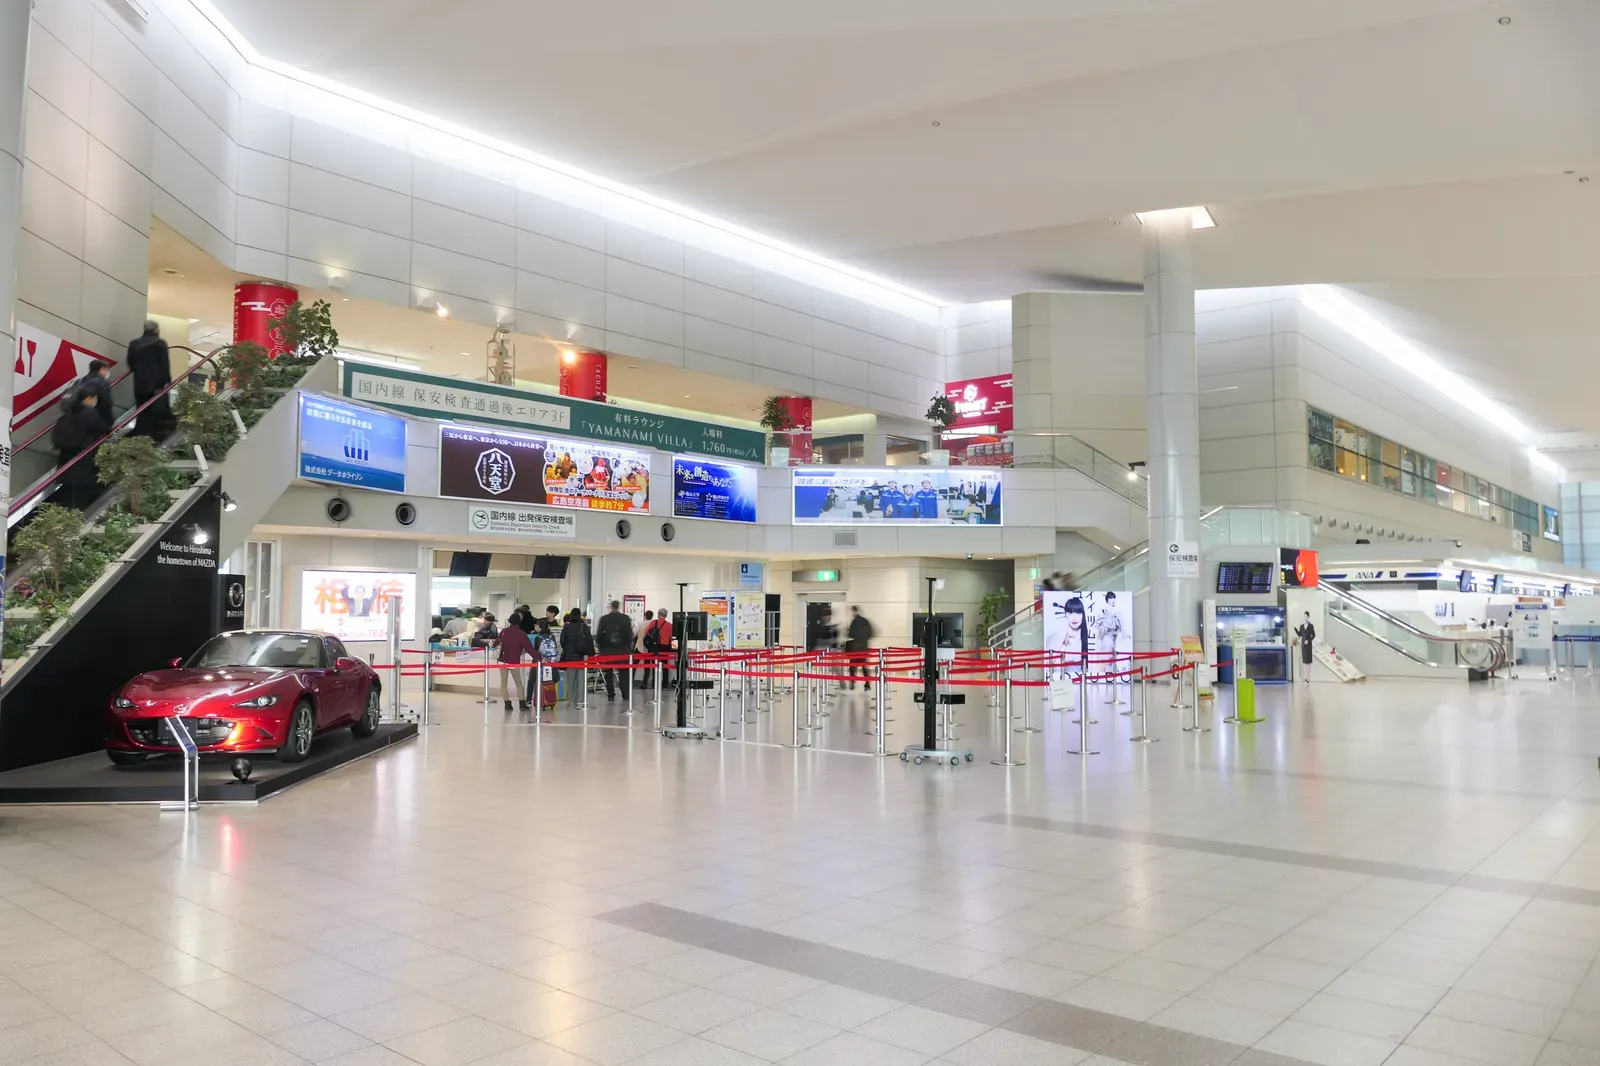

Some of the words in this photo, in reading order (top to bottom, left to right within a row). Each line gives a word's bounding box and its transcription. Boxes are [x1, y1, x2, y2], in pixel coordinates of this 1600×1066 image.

[358, 378, 405, 400] 国内線
[413, 383, 566, 423] 保安検査通過後エリア3F
[614, 412, 665, 429] 有料ラウンジ
[702, 427, 723, 439] 入場料
[304, 464, 327, 476] 株式会社
[327, 468, 364, 481] データホライゾン
[487, 451, 504, 491] 八天堂
[552, 496, 589, 508] 広島空港前
[591, 499, 625, 511] 徒歩約7分
[490, 510, 516, 521] 国内線
[518, 513, 573, 526] 出発保安検査場
[510, 521, 531, 529] Departure
[532, 522, 547, 530] Security
[160, 541, 183, 553] Welcome
[183, 544, 189, 553] to
[157, 555, 166, 564] the
[166, 556, 192, 566] hometown
[192, 557, 198, 567] of
[198, 558, 216, 568] MAZDA
[1355, 571, 1374, 579] ANA
